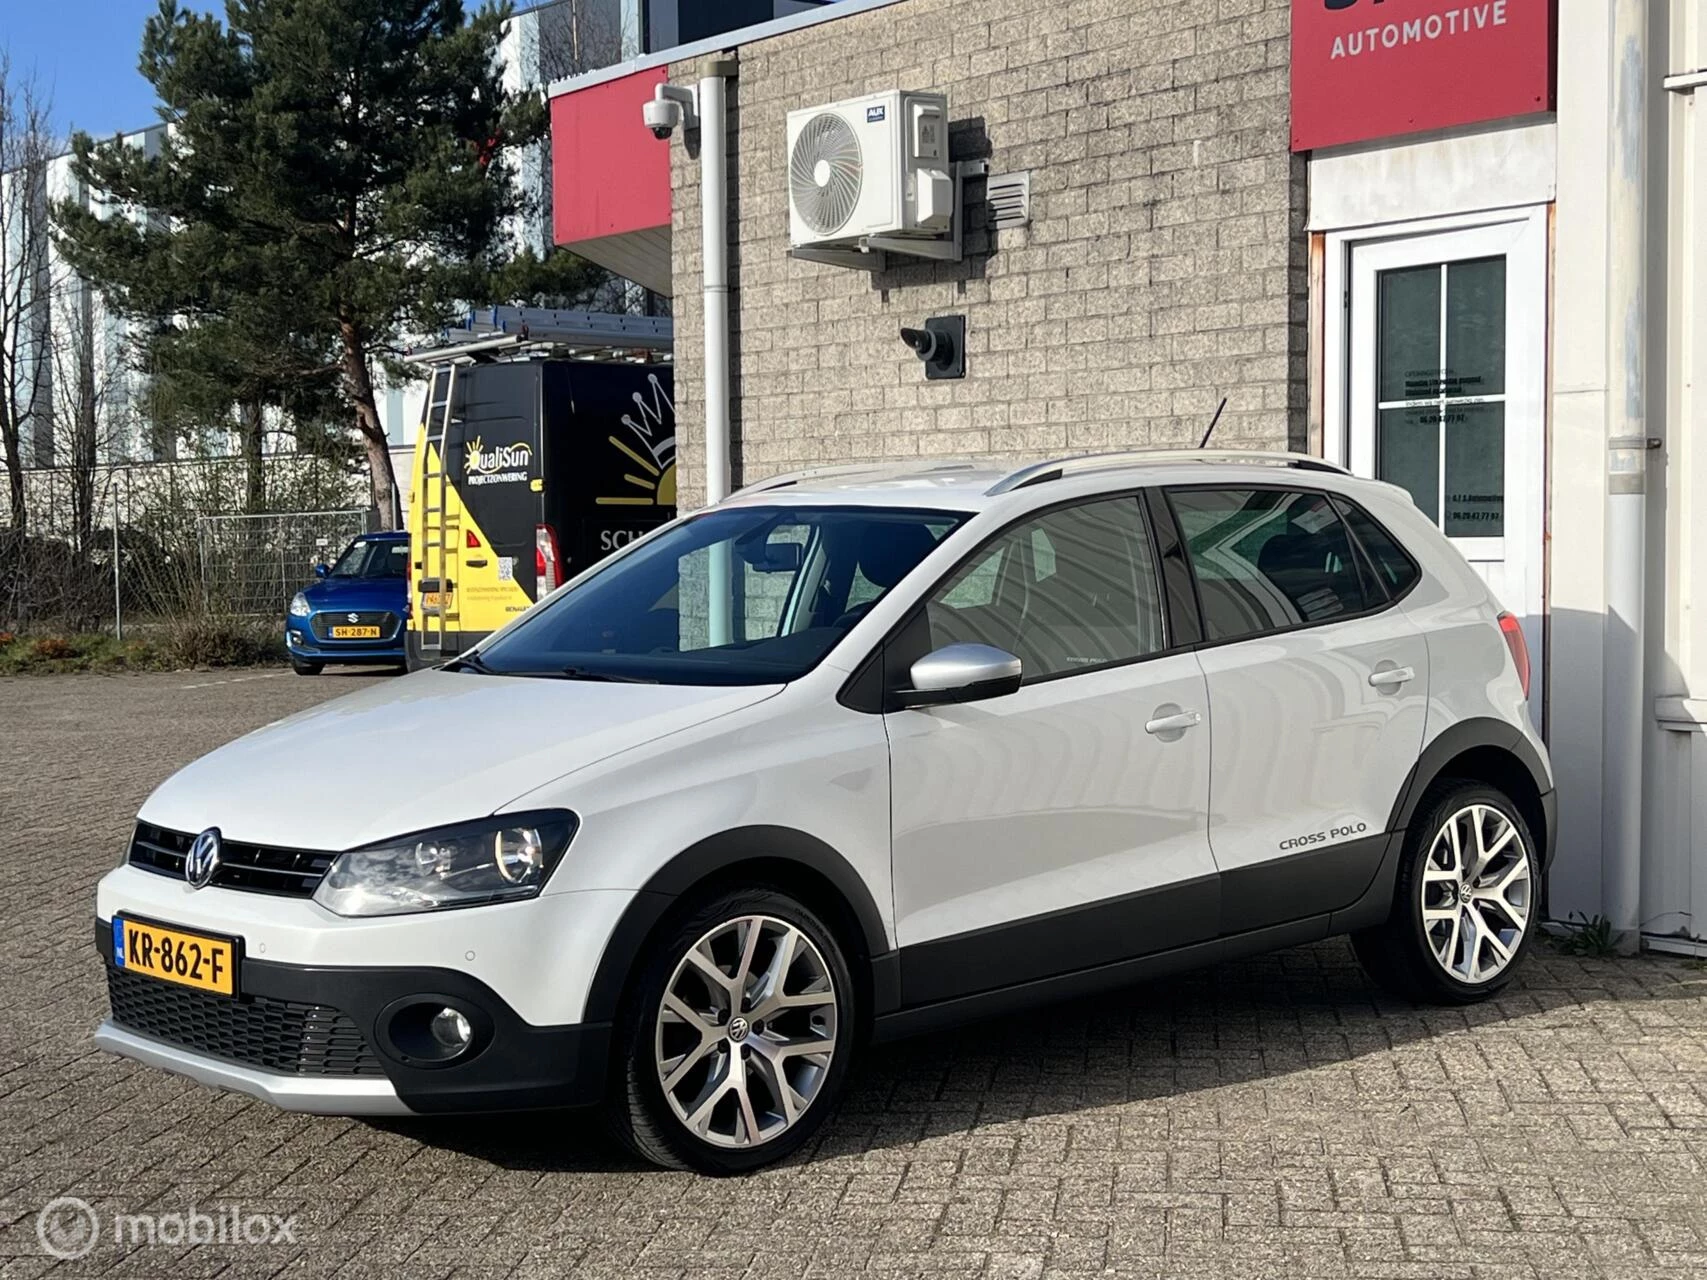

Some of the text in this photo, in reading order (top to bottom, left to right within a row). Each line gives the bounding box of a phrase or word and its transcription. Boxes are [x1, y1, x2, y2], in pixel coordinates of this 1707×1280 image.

[1330, 0, 1507, 60] AUTOMOTIVE
[466, 443, 530, 474] QualiSun
[1279, 823, 1367, 850] CROSS POLO
[128, 928, 225, 985] KR-862-F
